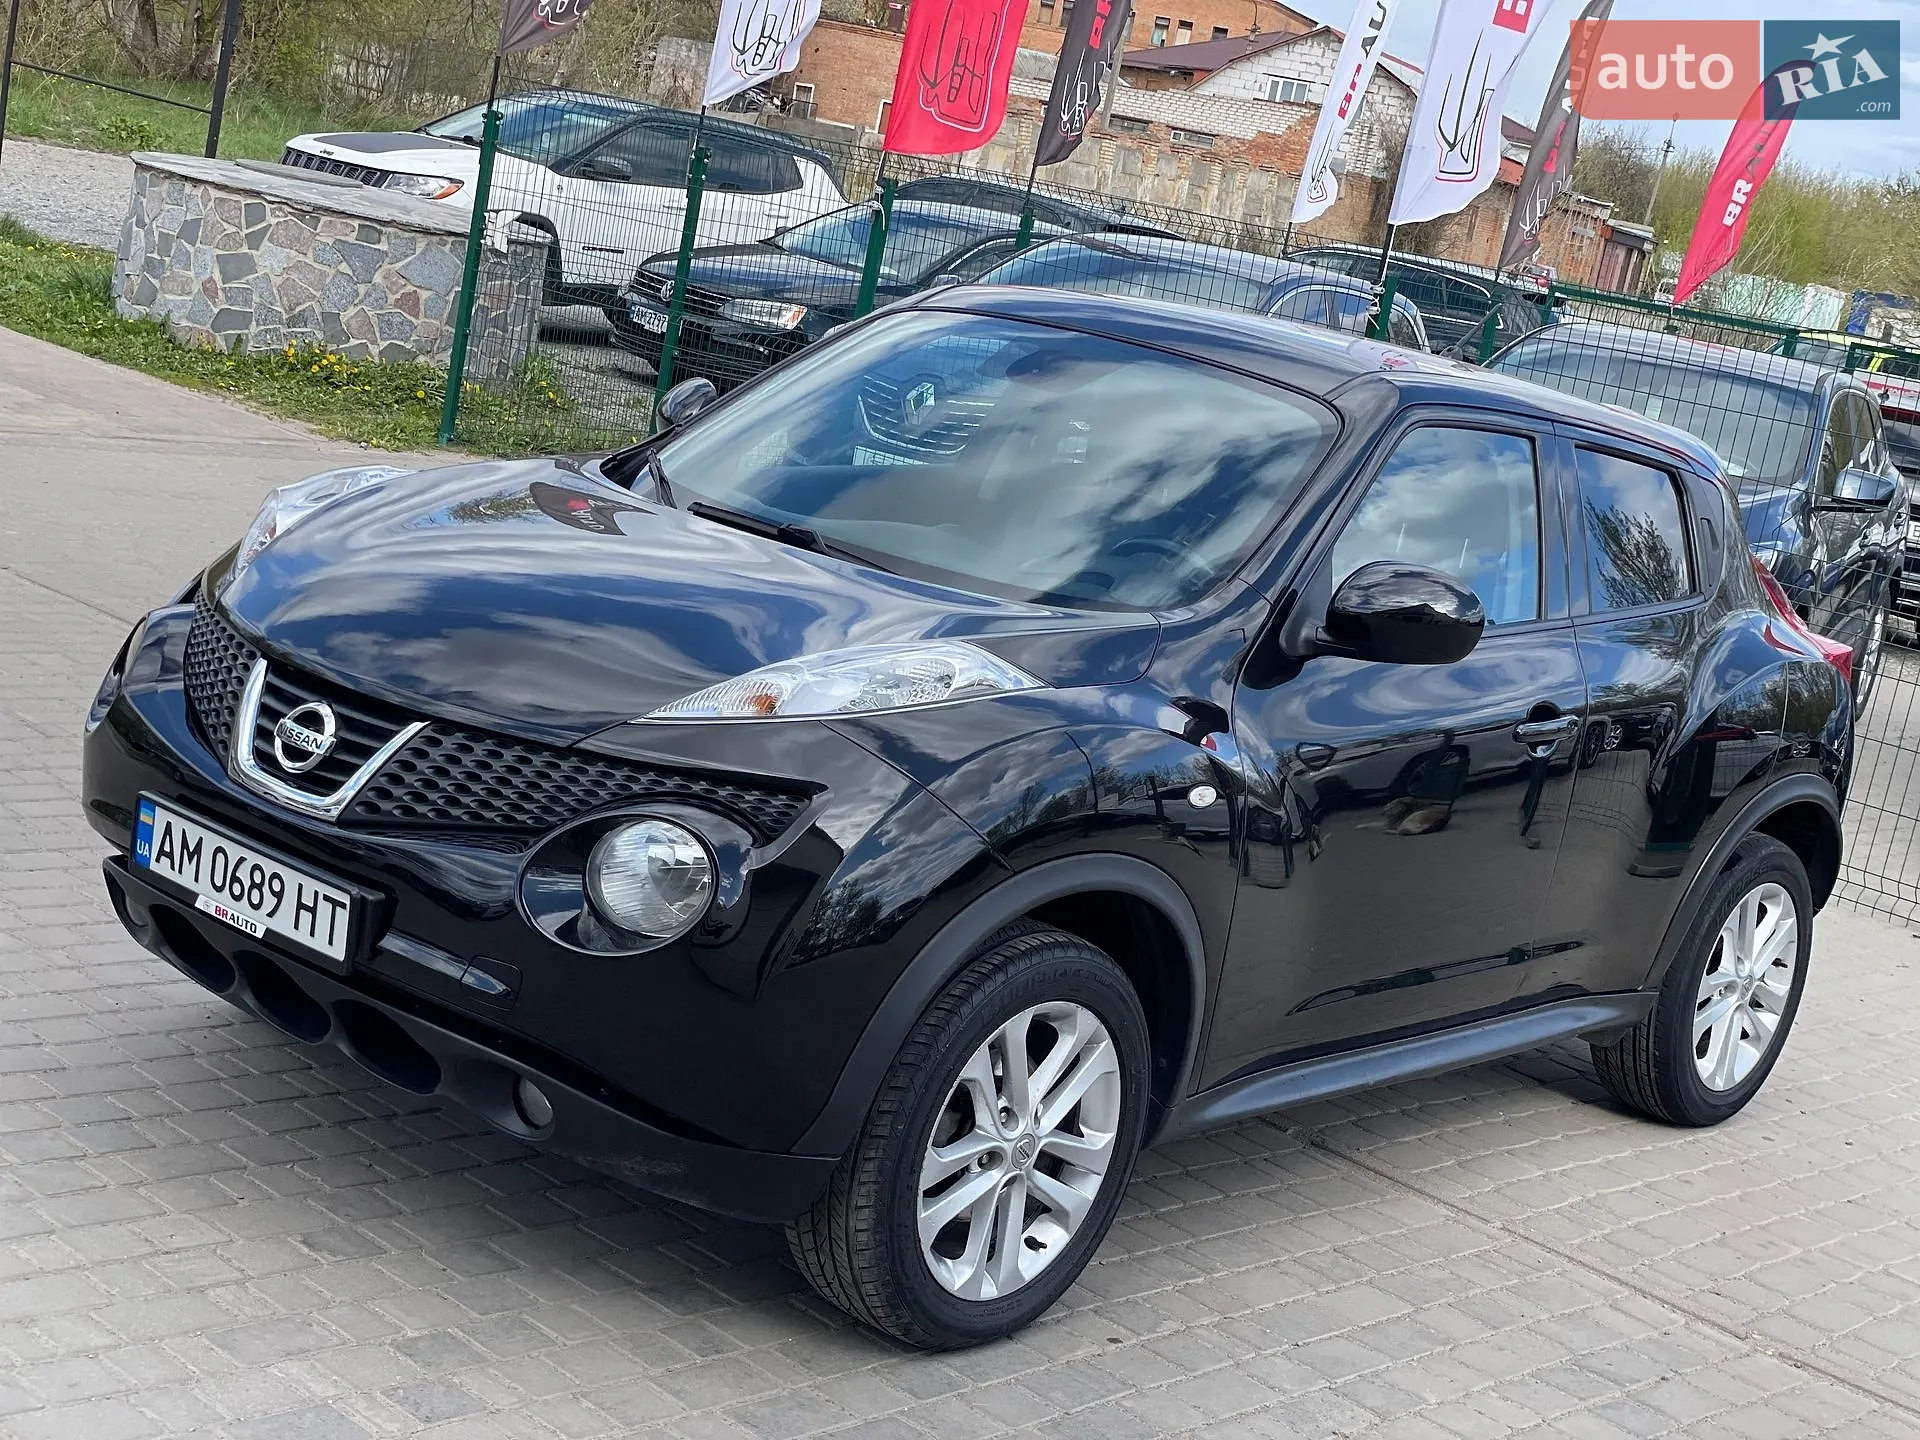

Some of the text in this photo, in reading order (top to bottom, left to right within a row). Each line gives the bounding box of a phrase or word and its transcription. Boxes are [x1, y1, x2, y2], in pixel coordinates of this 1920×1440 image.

[277, 721, 324, 750] NISSAN
[136, 839, 150, 858] UA
[155, 819, 347, 947] AM 0689 HT
[214, 905, 258, 934] BRAUTO
